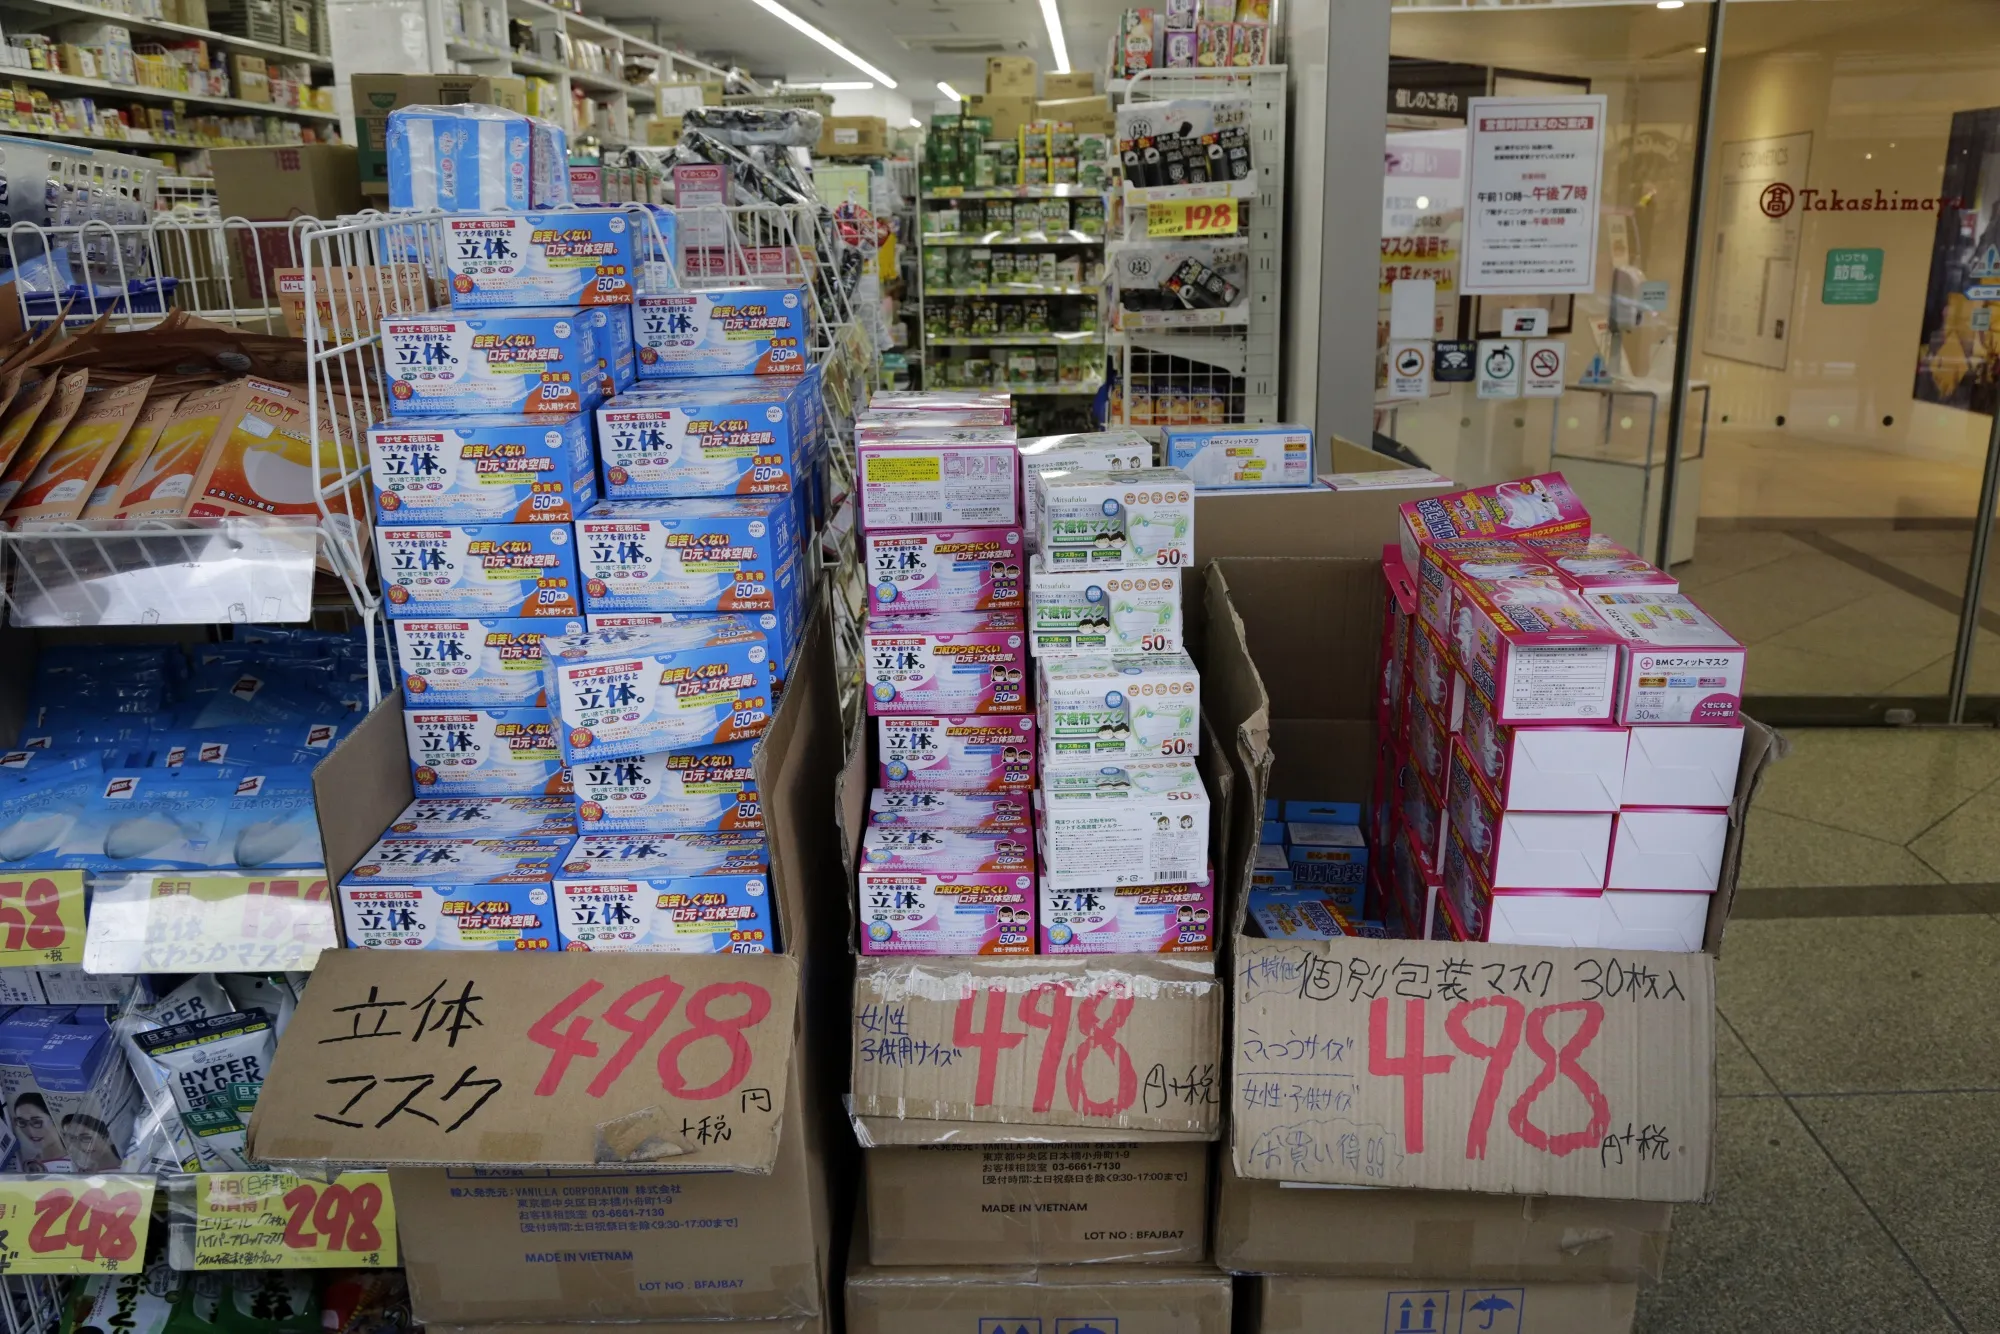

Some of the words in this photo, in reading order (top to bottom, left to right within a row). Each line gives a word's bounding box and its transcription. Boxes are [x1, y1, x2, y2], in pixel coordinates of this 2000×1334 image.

[1185, 204, 1231, 230] 198
[532, 230, 592, 242] 息苦しくない
[457, 238, 517, 259] 立体。
[545, 243, 619, 256] 口元・立体空間。
[712, 306, 766, 317] 息苦しくない
[643, 315, 699, 333] 立体。
[724, 317, 791, 330] 口元・立体空間。
[472, 335, 535, 347] 息苦しくない
[395, 344, 458, 365] 立体。
[487, 349, 563, 362] 口元・立体空間。
[246, 396, 299, 422] HOT
[687, 421, 747, 434] 息苦しくない
[611, 430, 672, 451] 立体。
[701, 434, 775, 446] 口元・立体空間。
[461, 445, 525, 458] 息苦しくない
[382, 453, 447, 475] 立体。
[477, 459, 555, 471] 口元・立体空間。
[469, 542, 531, 554] 息苦しくない
[667, 535, 729, 547] 息苦しくない
[934, 543, 1000, 554] 口紅がつきにくい
[391, 549, 454, 570] 立体。
[483, 555, 559, 567] 口元・立体空間。
[590, 542, 652, 563] 立体。
[1156, 548, 1180, 565] 50
[410, 640, 472, 660] 立体。
[933, 645, 1001, 655] 口紅がつきにくい
[1141, 634, 1165, 651] 50
[1656, 658, 1729, 666] BMCフィットマスク
[575, 684, 645, 711] 立体。
[1635, 710, 1659, 720] 30枚入
[946, 727, 1012, 736] 口紅がつきにくい
[420, 732, 480, 752] 立体。
[1161, 738, 1185, 755] 50
[585, 765, 651, 786] 立体。
[110, 781, 129, 790] NEW
[1299, 953, 1553, 1002] 個別包装マスク
[1575, 958, 1685, 1002] 30枚入
[318, 978, 484, 1047] 立体
[856, 1004, 908, 1036] 女性
[526, 974, 771, 1100] 498
[1244, 1030, 1354, 1061] ふつうサイズ
[860, 1036, 961, 1068] 子供用サイズ
[952, 981, 1138, 1119] 498
[180, 1055, 259, 1085] HYPER
[1368, 996, 1611, 1160] 498
[183, 1069, 263, 1098] BLOCK
[314, 1066, 503, 1134] マスク
[741, 1087, 771, 1113] 円
[983, 1164, 1047, 1173] お客様相談室
[1052, 1162, 1120, 1170] 03-6661-7130
[516, 1187, 557, 1196] VANILLA
[563, 1185, 628, 1196] CORPORATION
[636, 1184, 682, 1194] 株式会社
[592, 1208, 664, 1218] 03-6661-7130
[982, 1204, 1015, 1212] MADE
[1035, 1203, 1087, 1211] VIETNAM
[29, 1188, 142, 1262] 248
[283, 1183, 382, 1252] 298
[1085, 1232, 1105, 1240] LOT
[1109, 1231, 1126, 1239] NO
[1137, 1231, 1184, 1239] BFAJBA7
[525, 1253, 561, 1262] MADE
[564, 1253, 576, 1261] IN
[580, 1252, 633, 1261] VIETNAM
[639, 1282, 660, 1291] LOT
[665, 1282, 684, 1290] NO
